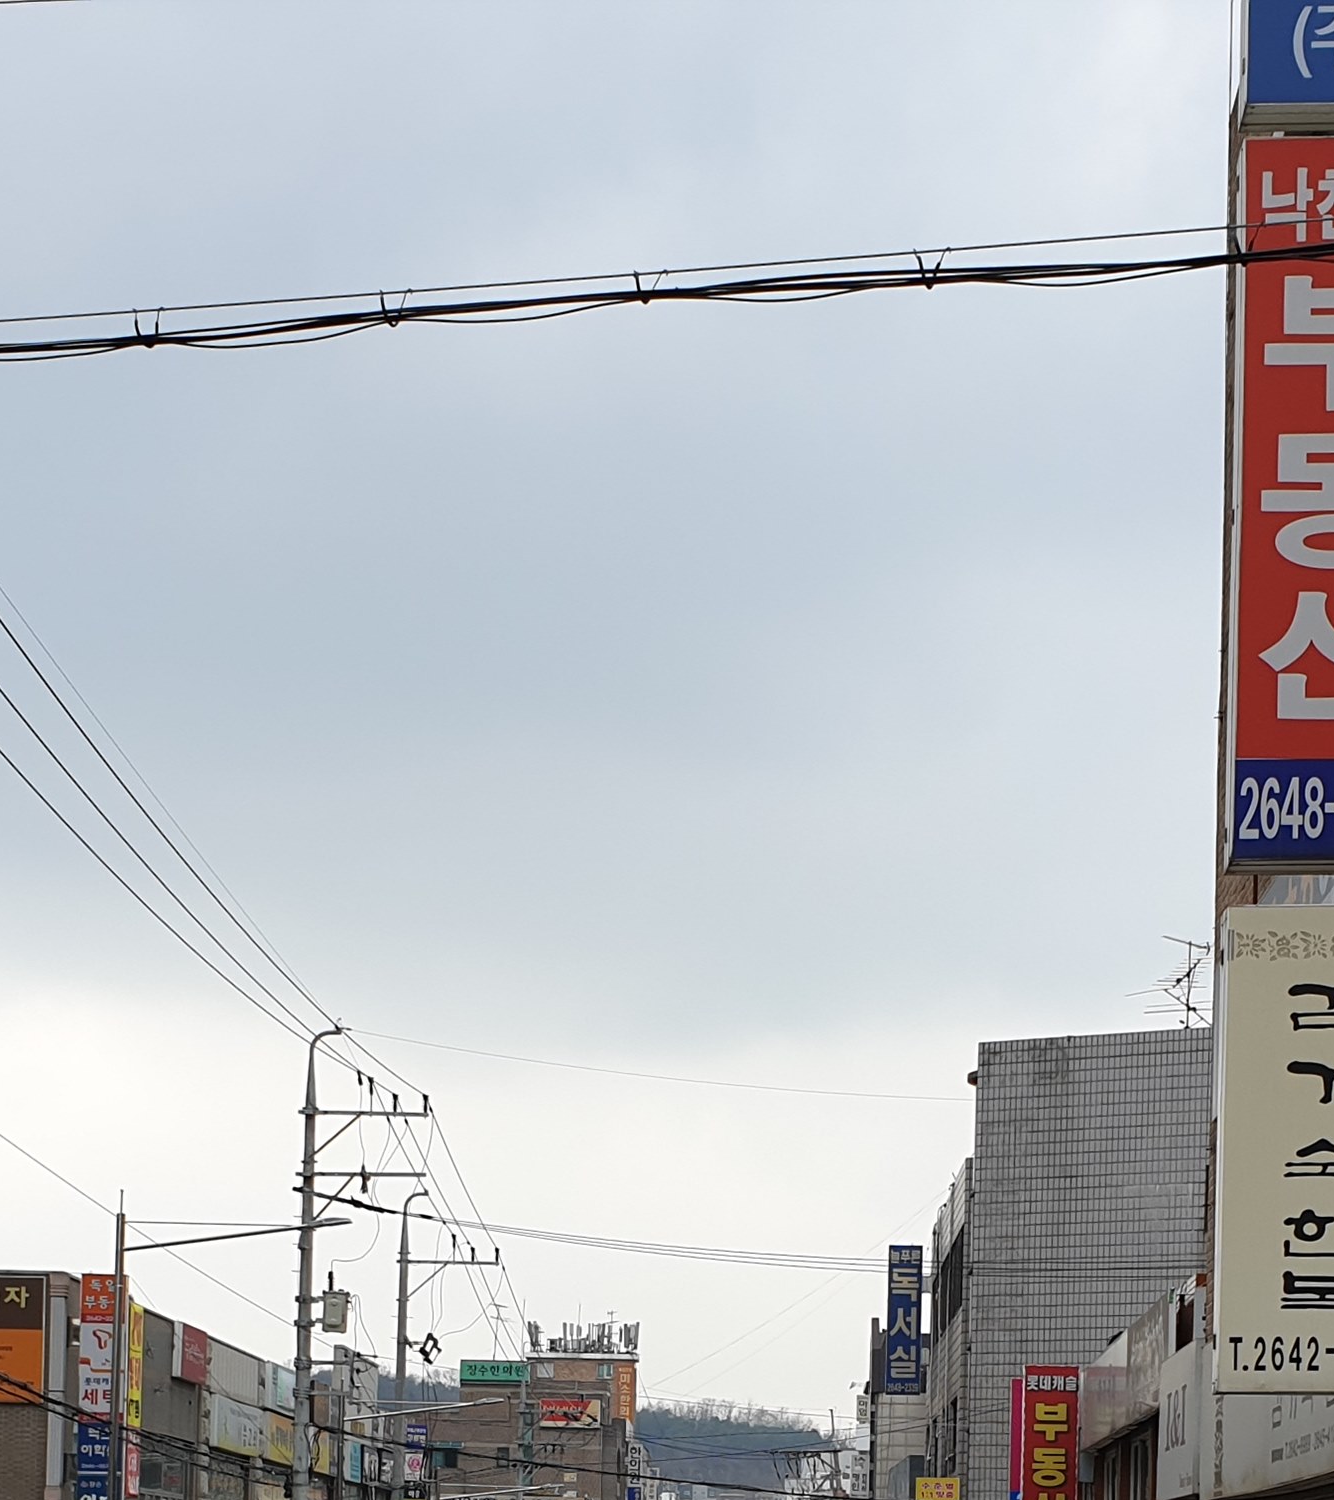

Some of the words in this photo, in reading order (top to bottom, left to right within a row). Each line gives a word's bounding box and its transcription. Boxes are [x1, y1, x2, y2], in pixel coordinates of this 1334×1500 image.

[84, 1295, 115, 1309] 부동
[889, 1268, 919, 1379] 독서실
[1027, 1375, 1078, 1391] 롯데캐슬
